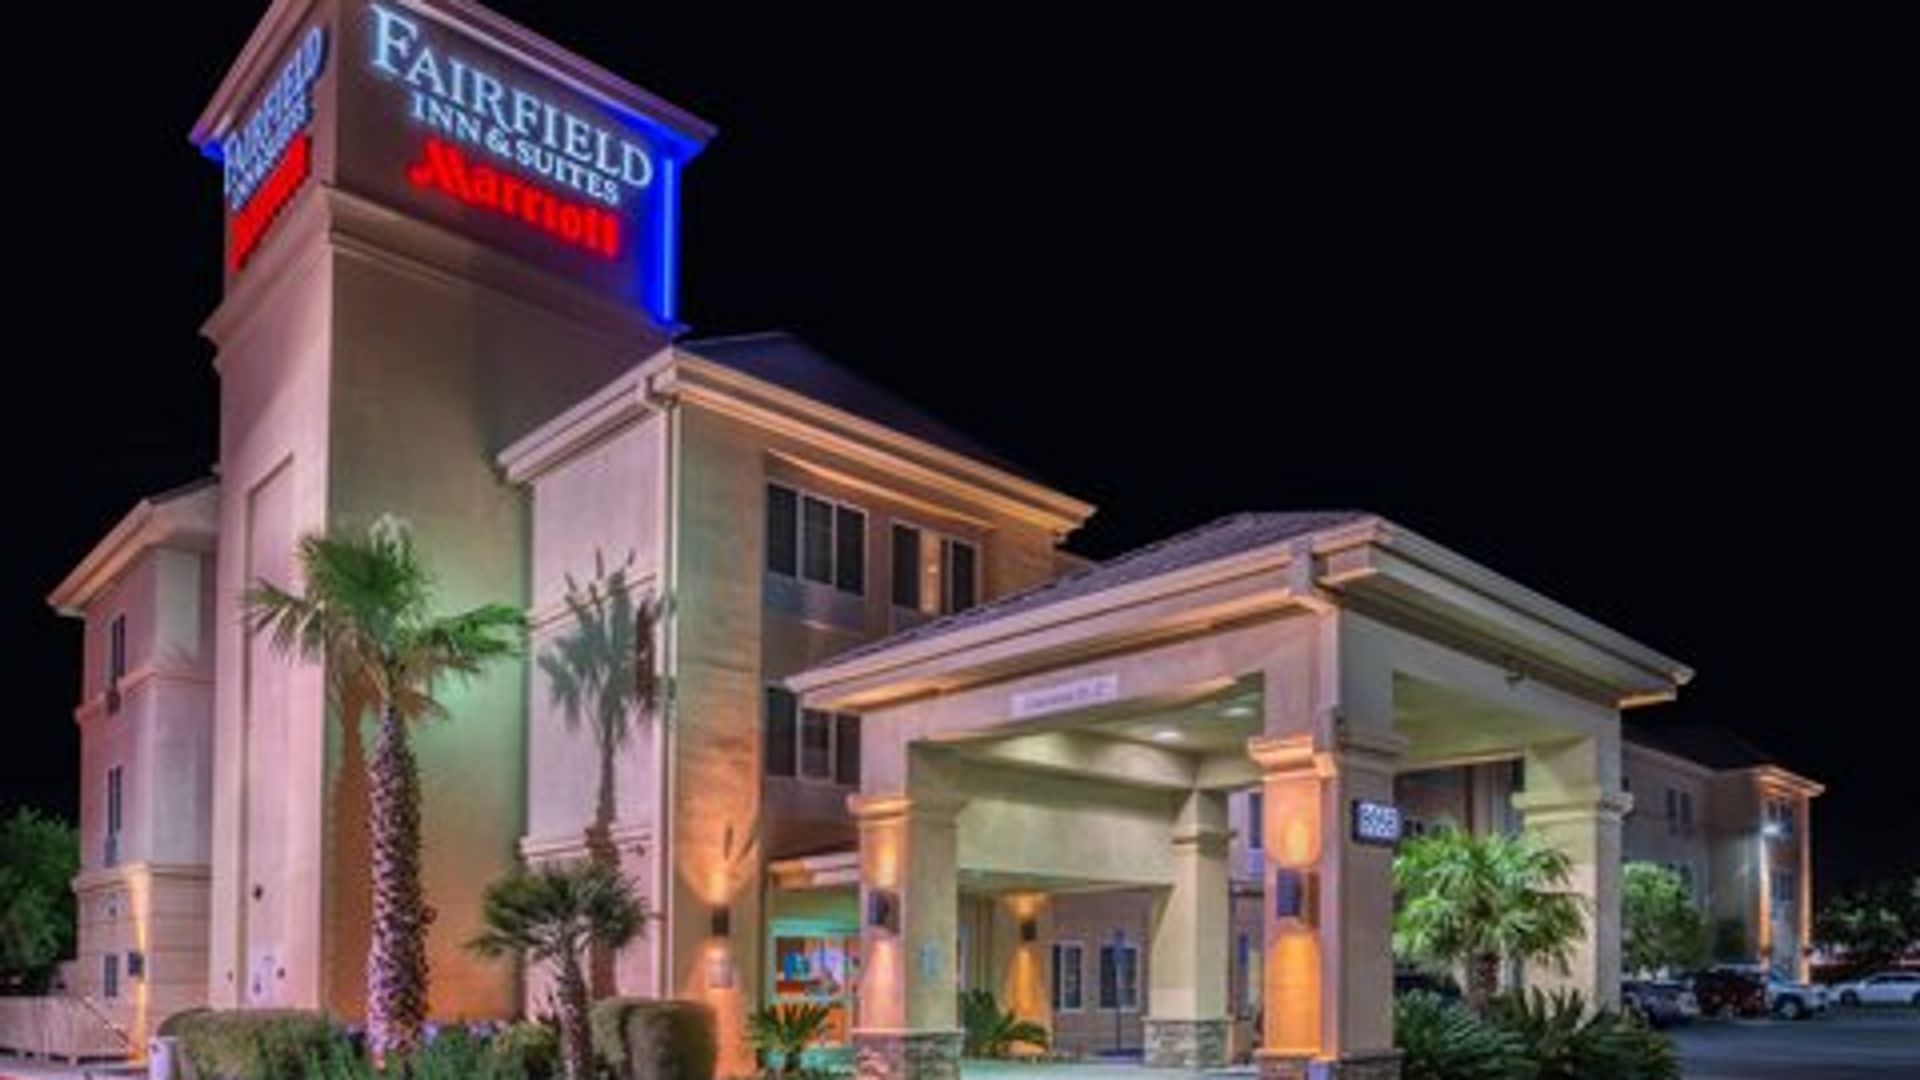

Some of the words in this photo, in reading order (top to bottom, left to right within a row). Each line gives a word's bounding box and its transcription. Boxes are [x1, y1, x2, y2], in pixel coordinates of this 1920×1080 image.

[371, 3, 653, 187] FAIRFIELD
[411, 91, 484, 146] INN
[516, 140, 620, 206] SUITES
